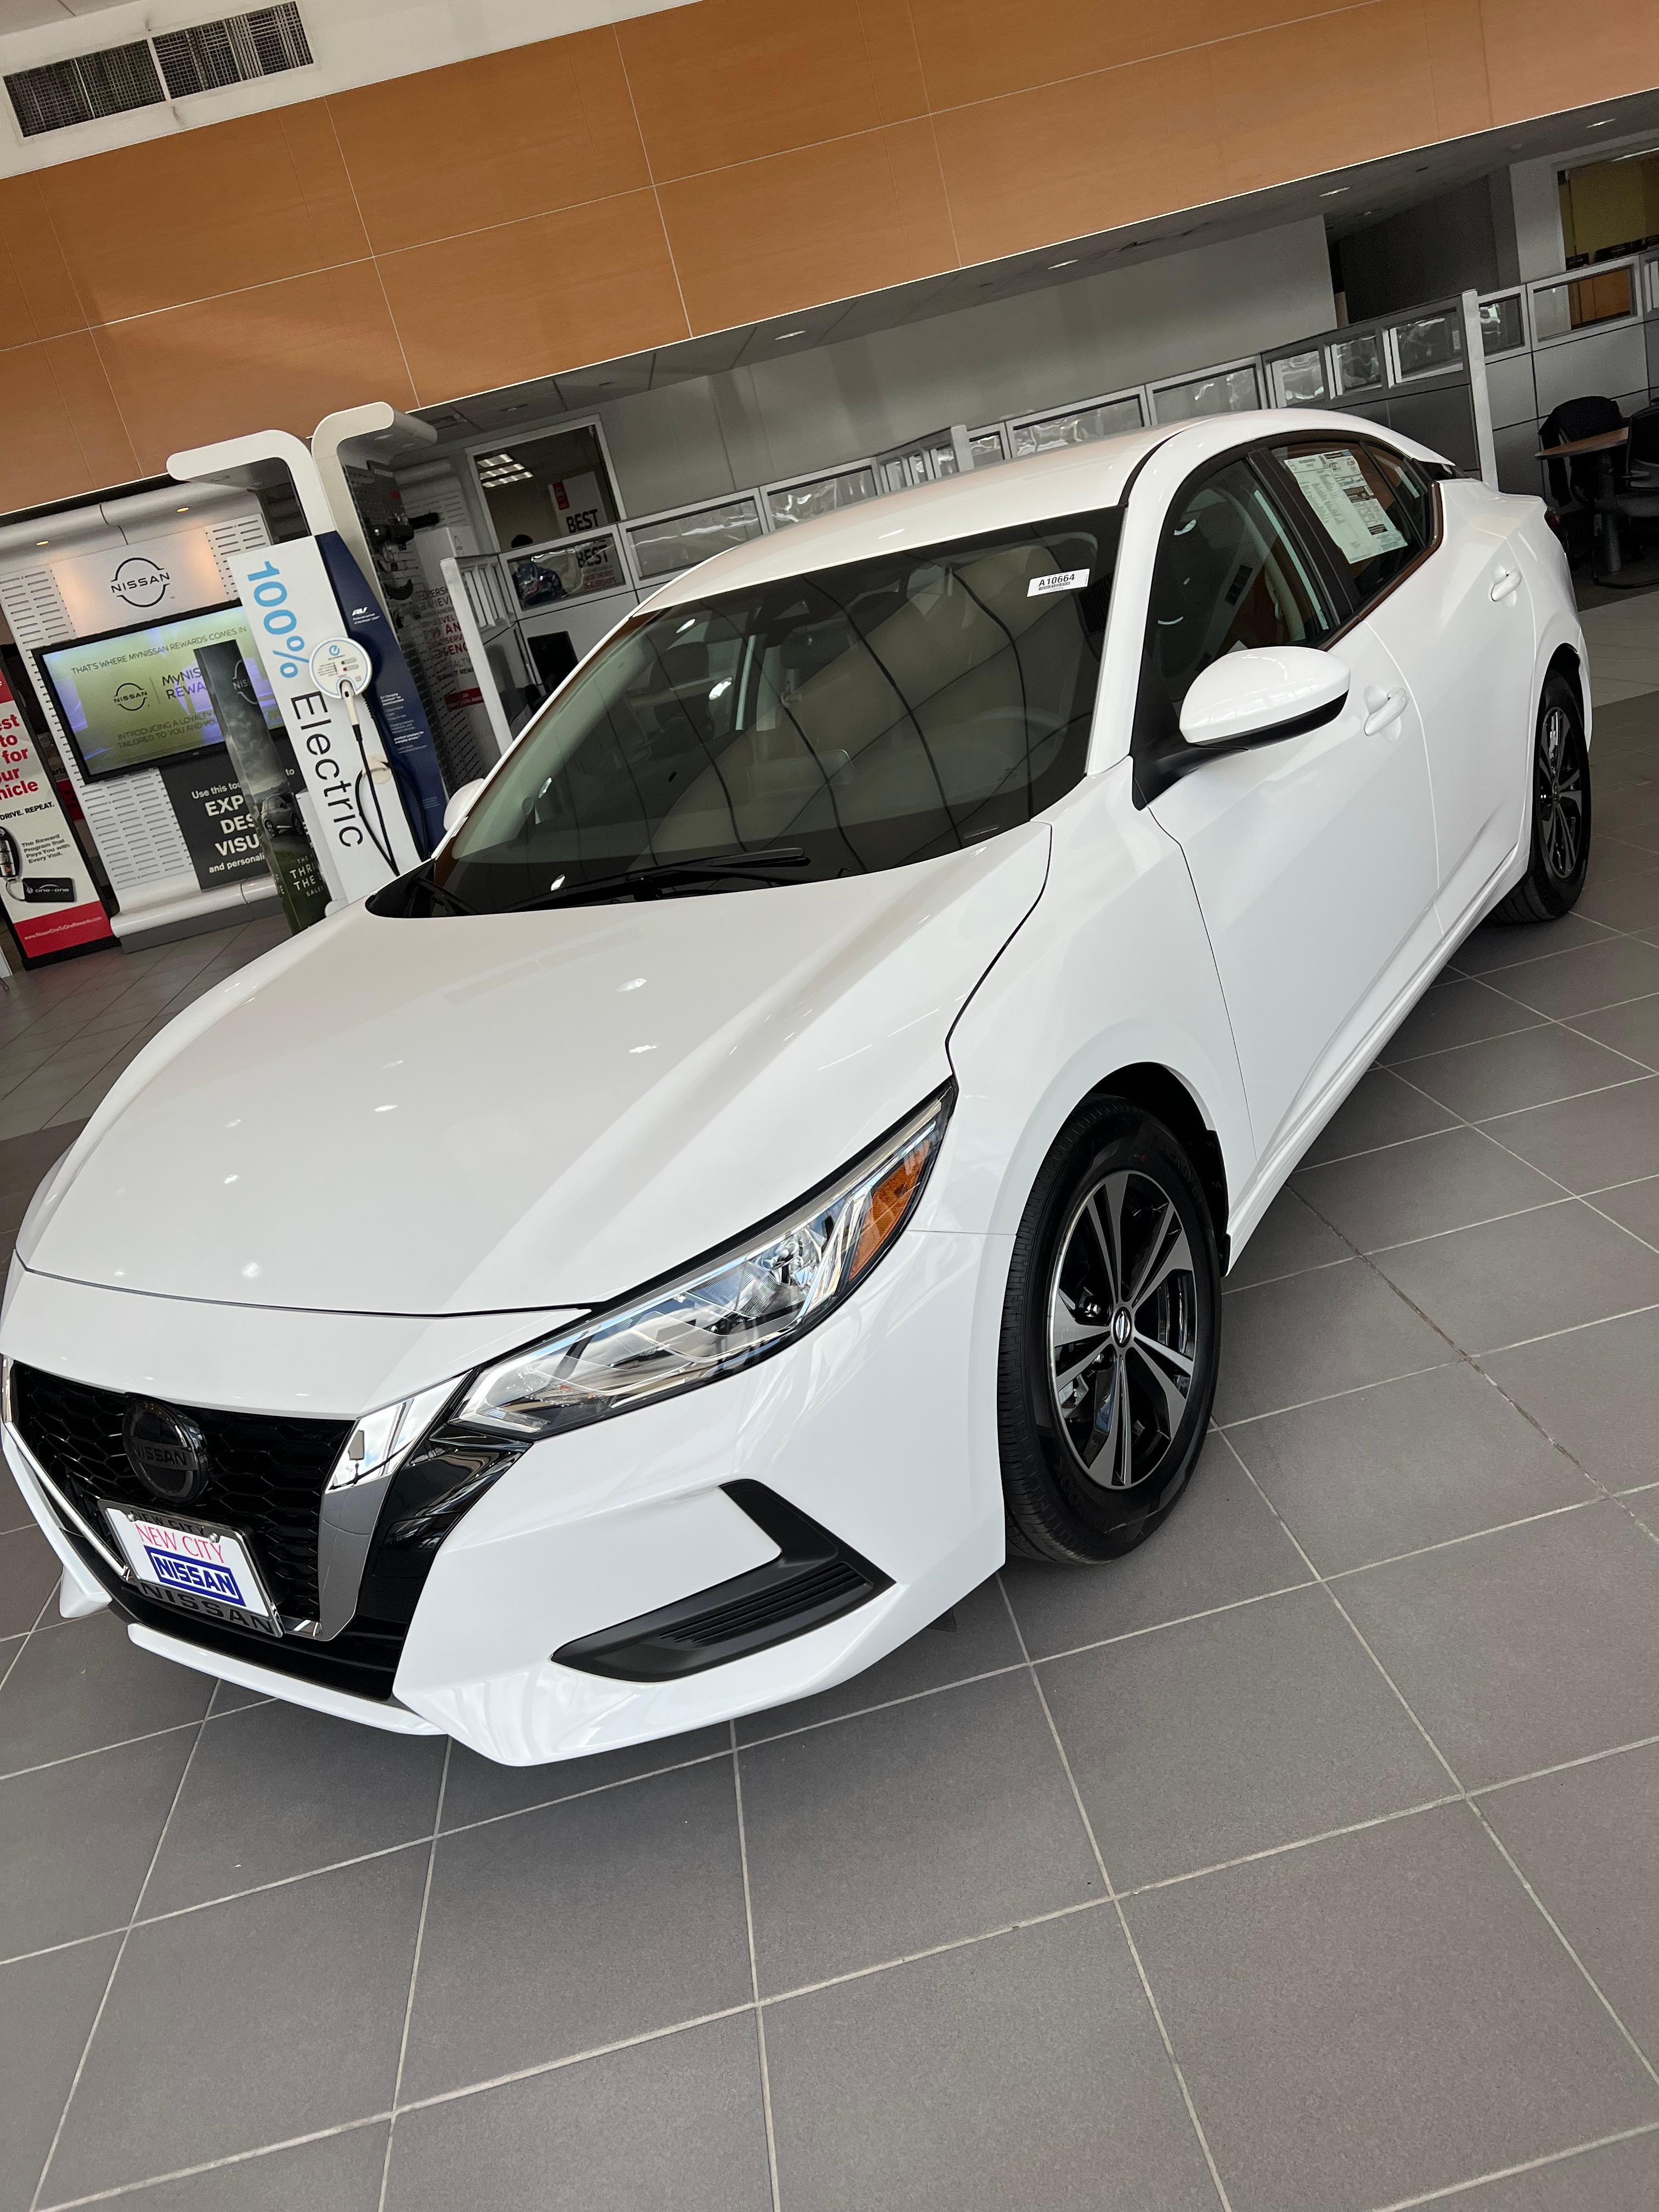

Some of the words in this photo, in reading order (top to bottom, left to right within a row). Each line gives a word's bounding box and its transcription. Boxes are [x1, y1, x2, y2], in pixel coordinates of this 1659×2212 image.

[566, 509, 598, 533] BEST
[111, 572, 170, 593] NISSAN
[1039, 573, 1075, 586] A10664
[247, 561, 310, 678] 100%
[71, 662, 99, 675] THAT'S
[99, 656, 127, 668] WHERE
[128, 646, 168, 661] MYNISSAN
[170, 636, 207, 651] REWARDS
[209, 629, 236, 640] COMES
[114, 691, 148, 703] NISSAN
[0, 714, 20, 731] st
[0, 735, 18, 747] to
[2, 748, 28, 764] for
[0, 768, 19, 783] ur
[291, 691, 363, 847] Electric
[191, 789, 210, 799] Use
[211, 785, 227, 794] this
[0, 810, 24, 820] DRIVE.
[25, 802, 54, 814] REPEAT.
[35, 834, 60, 844] Reward
[24, 843, 50, 853] Program
[29, 856, 46, 864] Every
[209, 862, 225, 873] and
[294, 875, 316, 891] THE
[132, 1443, 187, 1466] NISSAN
[168, 1520, 205, 1536] CITY
[135, 1523, 177, 1551] NEW
[182, 1536, 225, 1564] CITY
[153, 1556, 236, 1596] NISSAN
[141, 1583, 274, 1634] NISSAN
